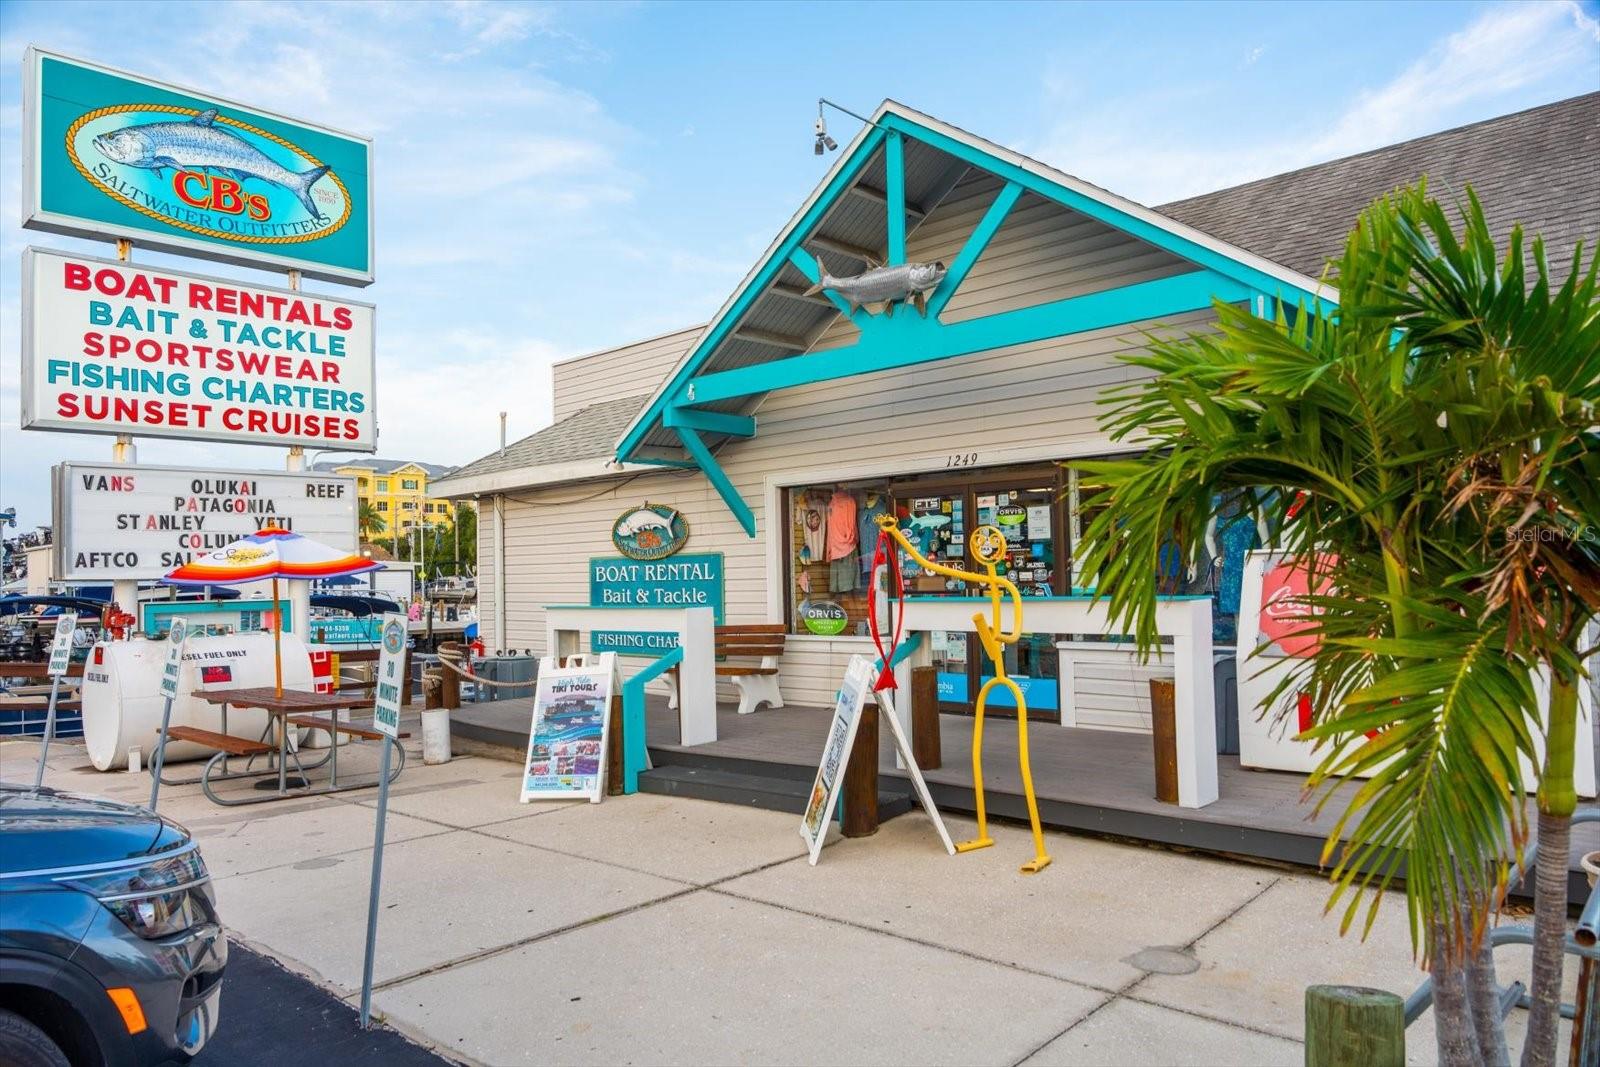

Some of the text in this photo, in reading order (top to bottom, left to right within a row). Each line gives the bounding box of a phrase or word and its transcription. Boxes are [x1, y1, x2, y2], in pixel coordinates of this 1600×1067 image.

[64, 262, 353, 330] BOAT RENTALS
[89, 300, 346, 358] BAIT & TACKLE
[83, 332, 340, 384] SPORTSWEAR
[48, 359, 365, 414] FISHING CHARTERS
[57, 392, 360, 440] SUNSET CRUISES
[946, 452, 978, 467] 1249
[82, 475, 345, 499] VANS OLUKAI REEF
[174, 496, 276, 514] PATAGONIA
[179, 533, 249, 549] COLUM
[75, 552, 138, 568] AFTCO
[595, 563, 714, 582] BOAT RENTAL
[603, 587, 707, 604] Bait & Tackle
[808, 609, 842, 619] ORVIS
[598, 634, 643, 647] FISHING
[181, 649, 247, 661] ESEL FUEL ONLY
[386, 660, 395, 678] 30
[379, 681, 398, 704] MINUTE
[552, 683, 598, 693] TIKI TOURS
[937, 682, 954, 690] mbia
[376, 704, 397, 728] PARKING
